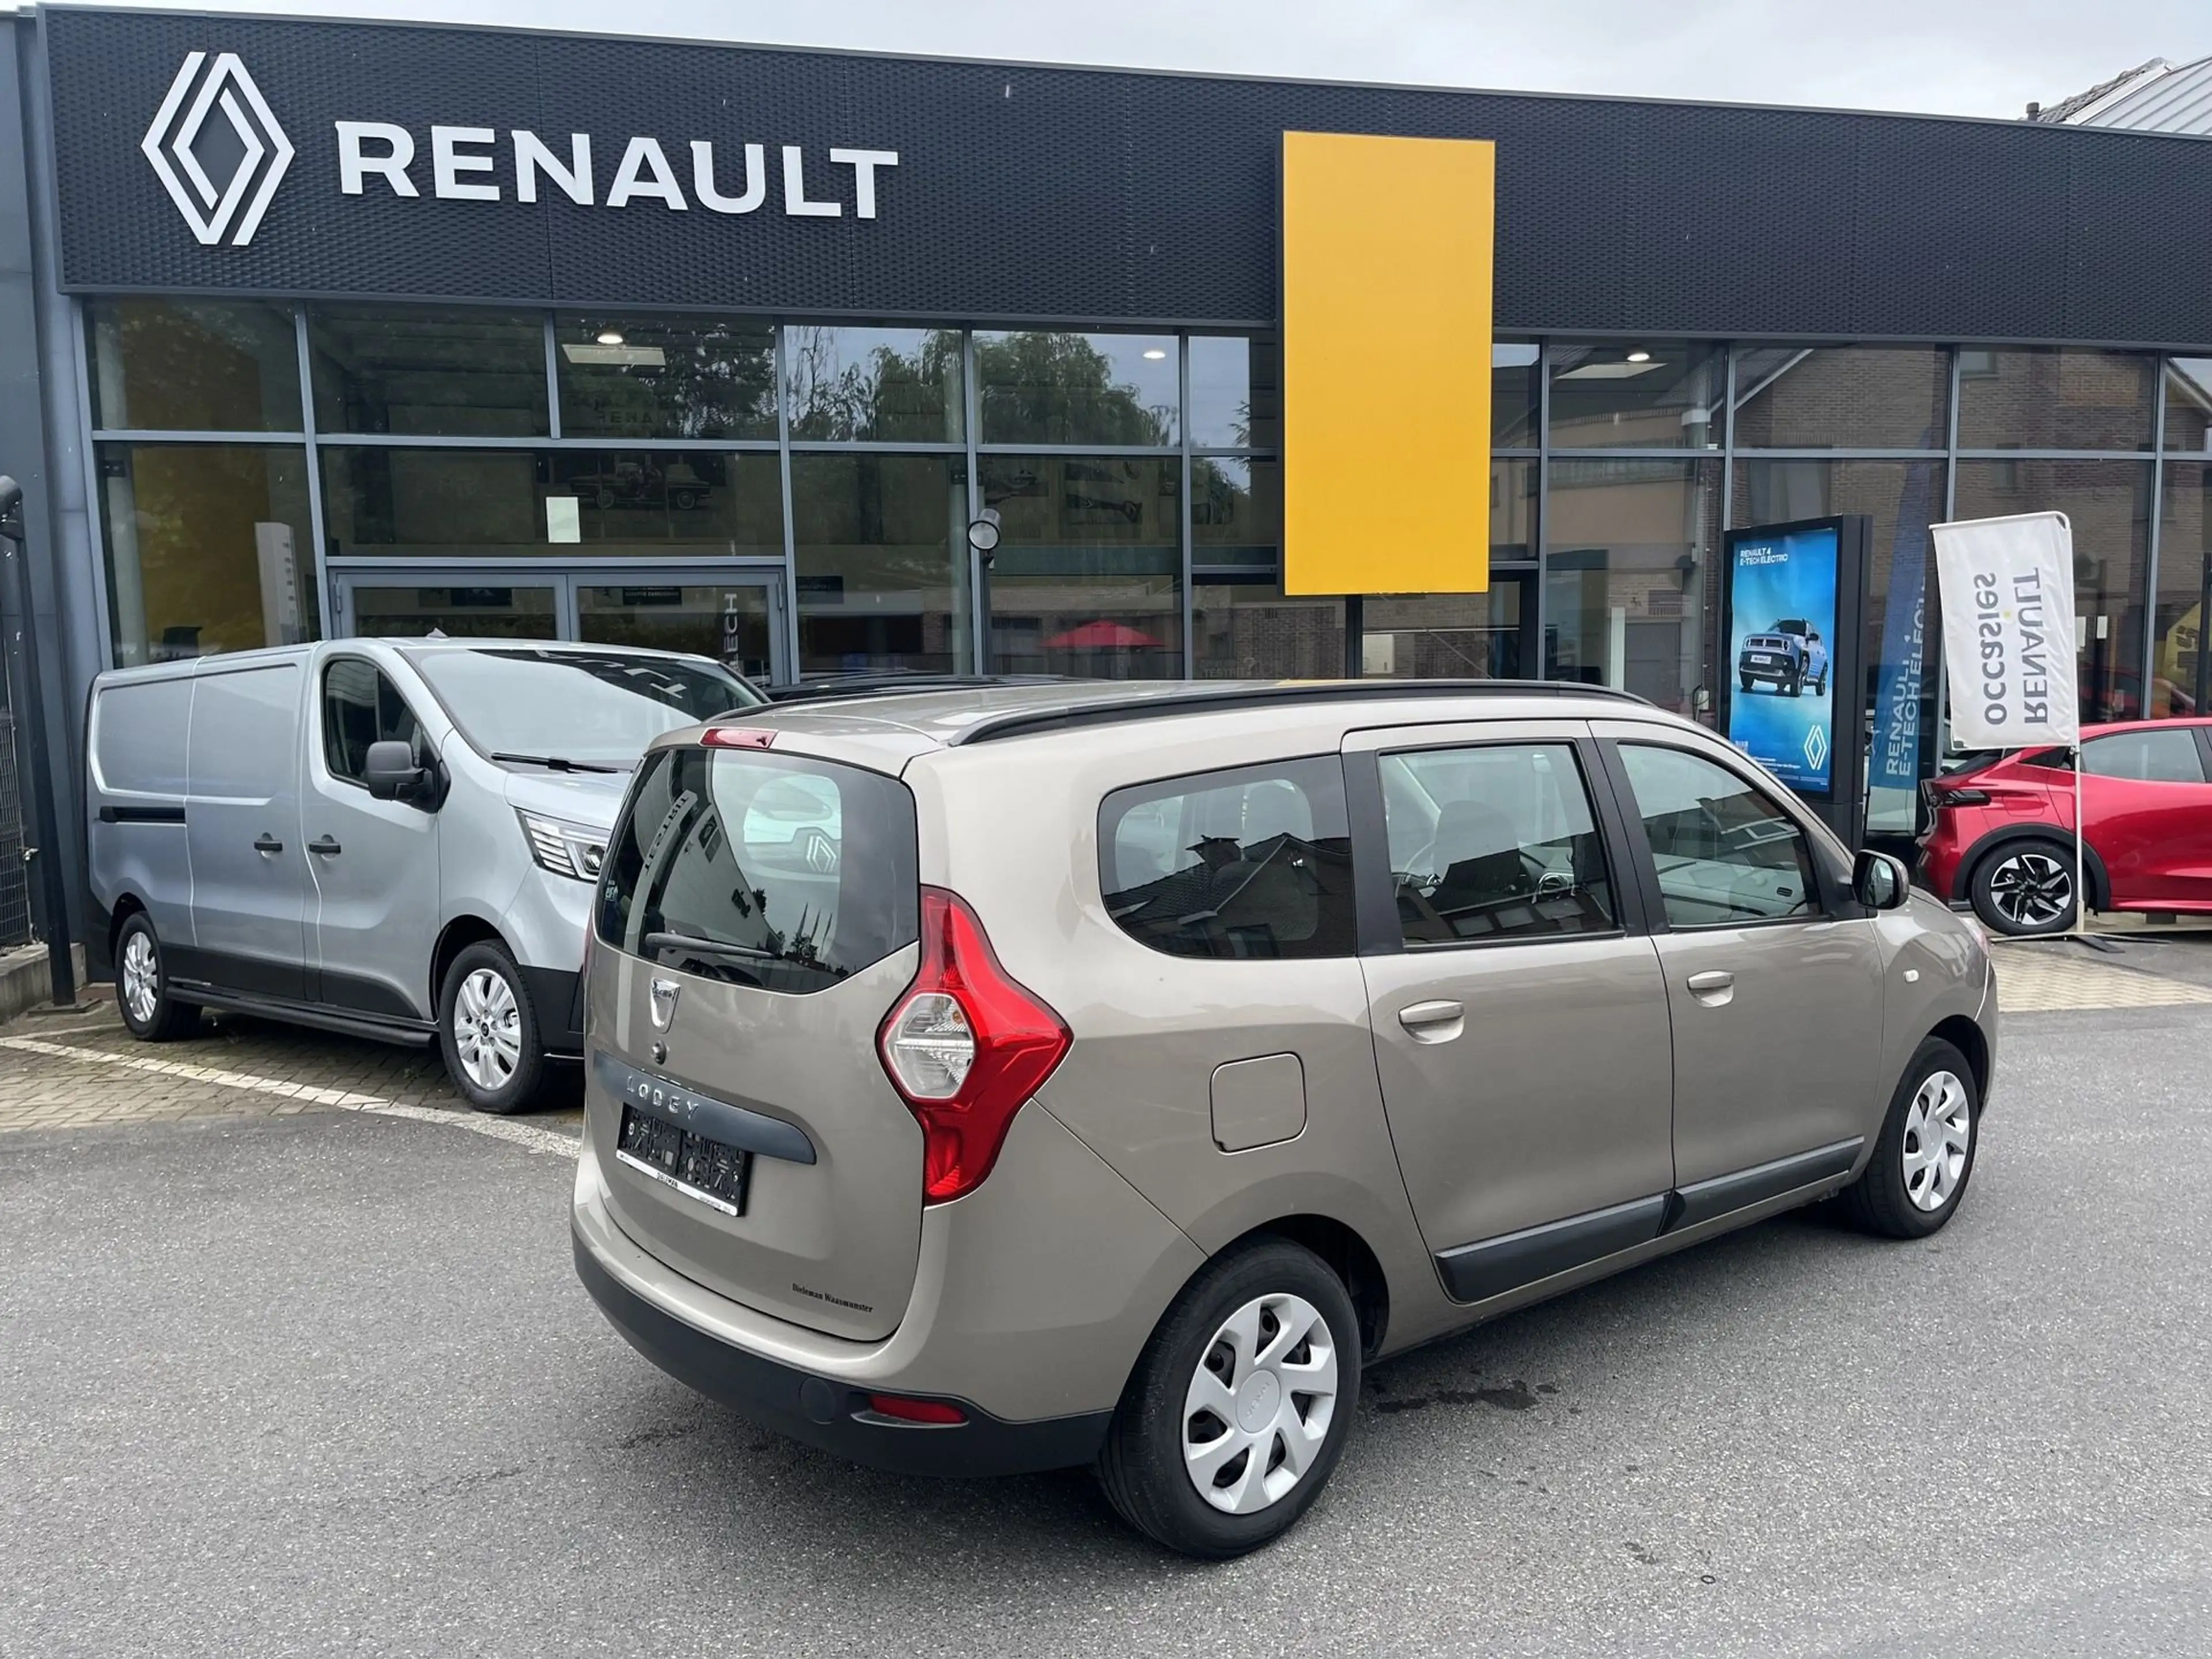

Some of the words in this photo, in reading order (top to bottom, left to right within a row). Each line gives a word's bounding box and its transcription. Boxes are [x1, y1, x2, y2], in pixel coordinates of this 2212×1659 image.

[335, 120, 898, 219] RENAULT
[1767, 547, 1771, 555] 4
[1899, 681, 1919, 776] E-TECH
[626, 1075, 700, 1120] LODGY
[792, 1282, 824, 1300] Dieleman
